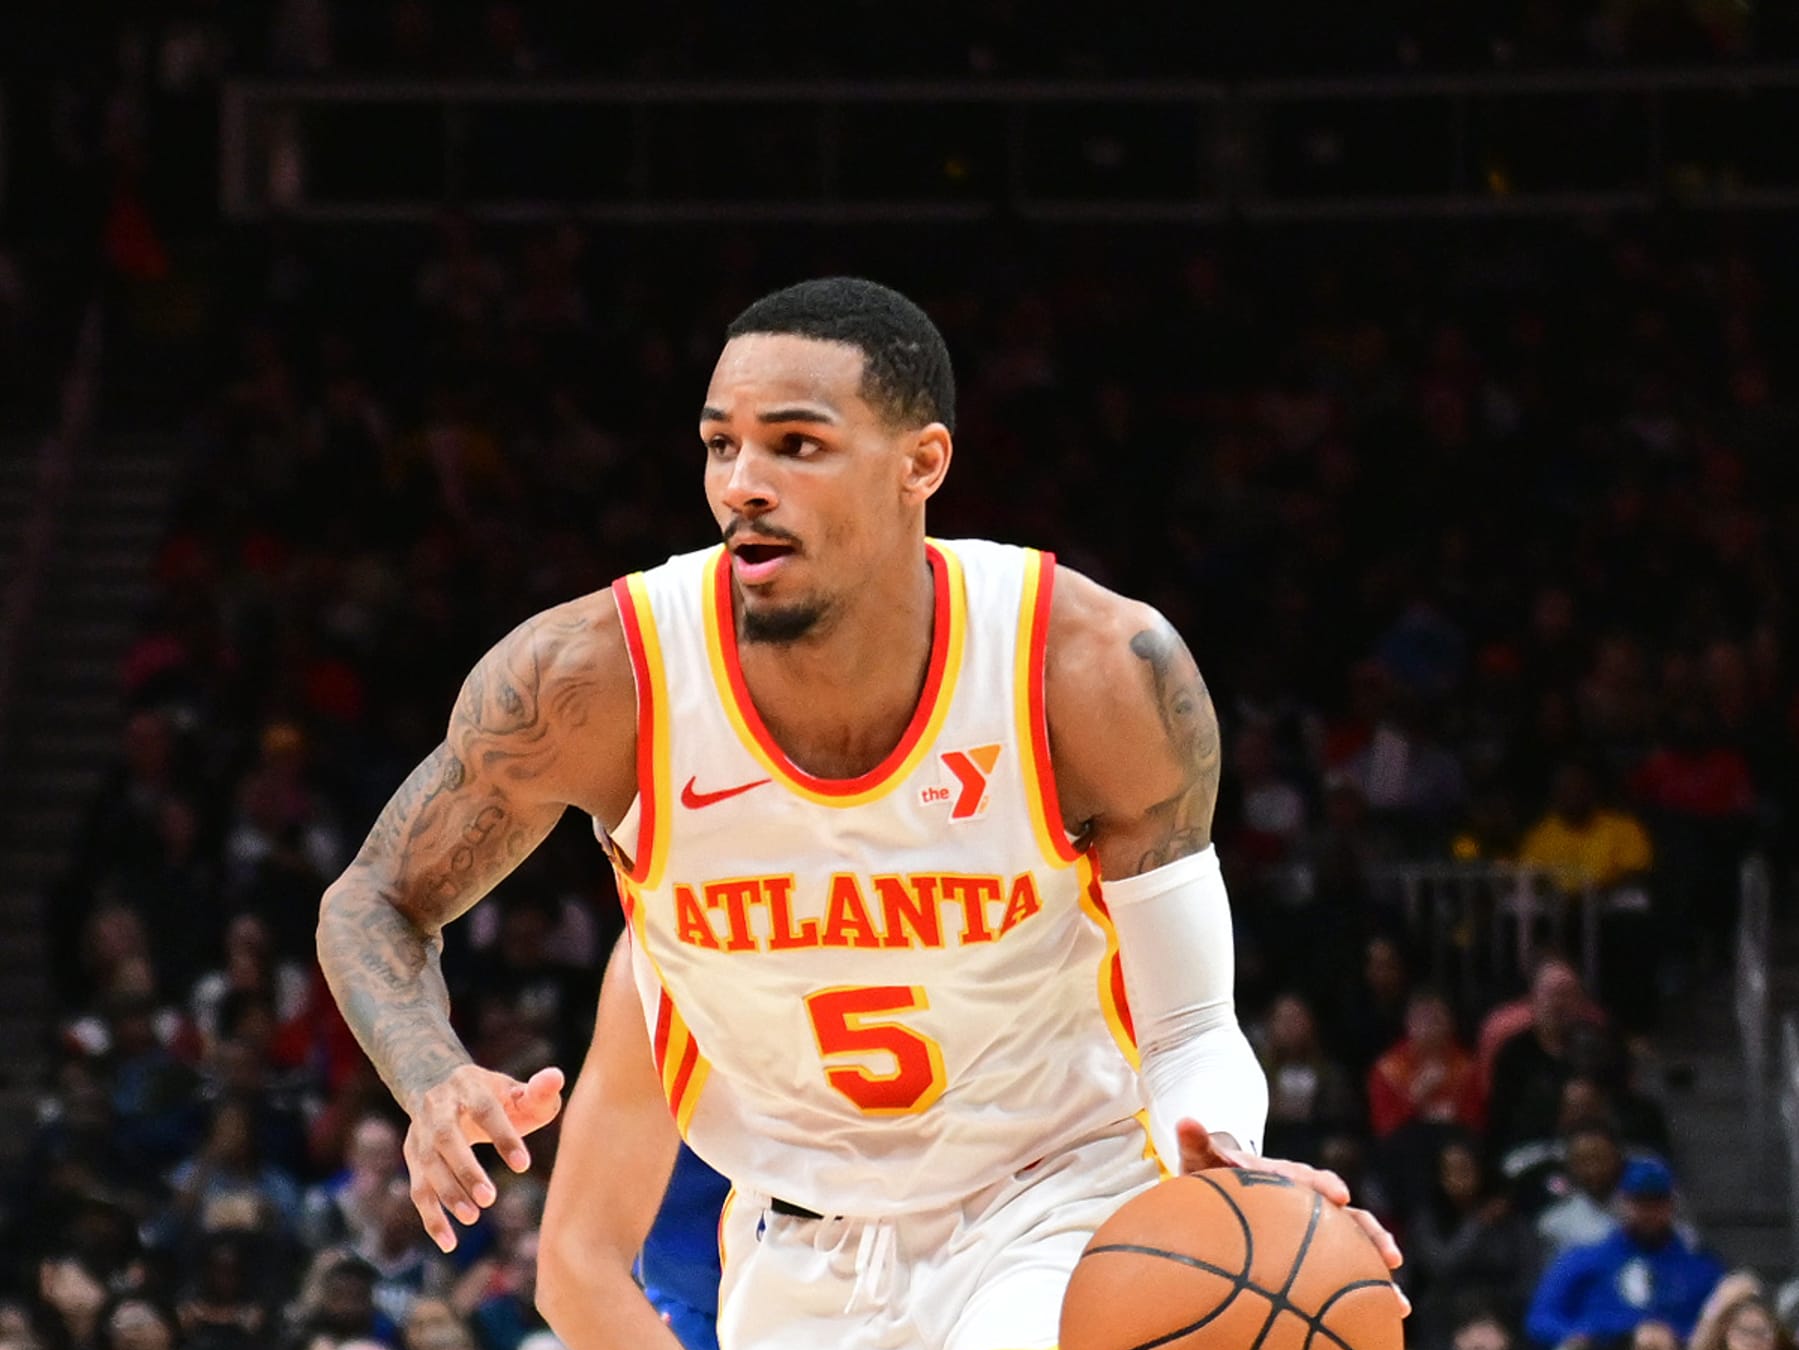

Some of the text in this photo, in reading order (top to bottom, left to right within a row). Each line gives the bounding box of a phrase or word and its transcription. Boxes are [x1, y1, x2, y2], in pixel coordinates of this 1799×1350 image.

[921, 787, 950, 803] the
[673, 871, 1042, 953] ATLANTA
[803, 985, 947, 1116] 5
